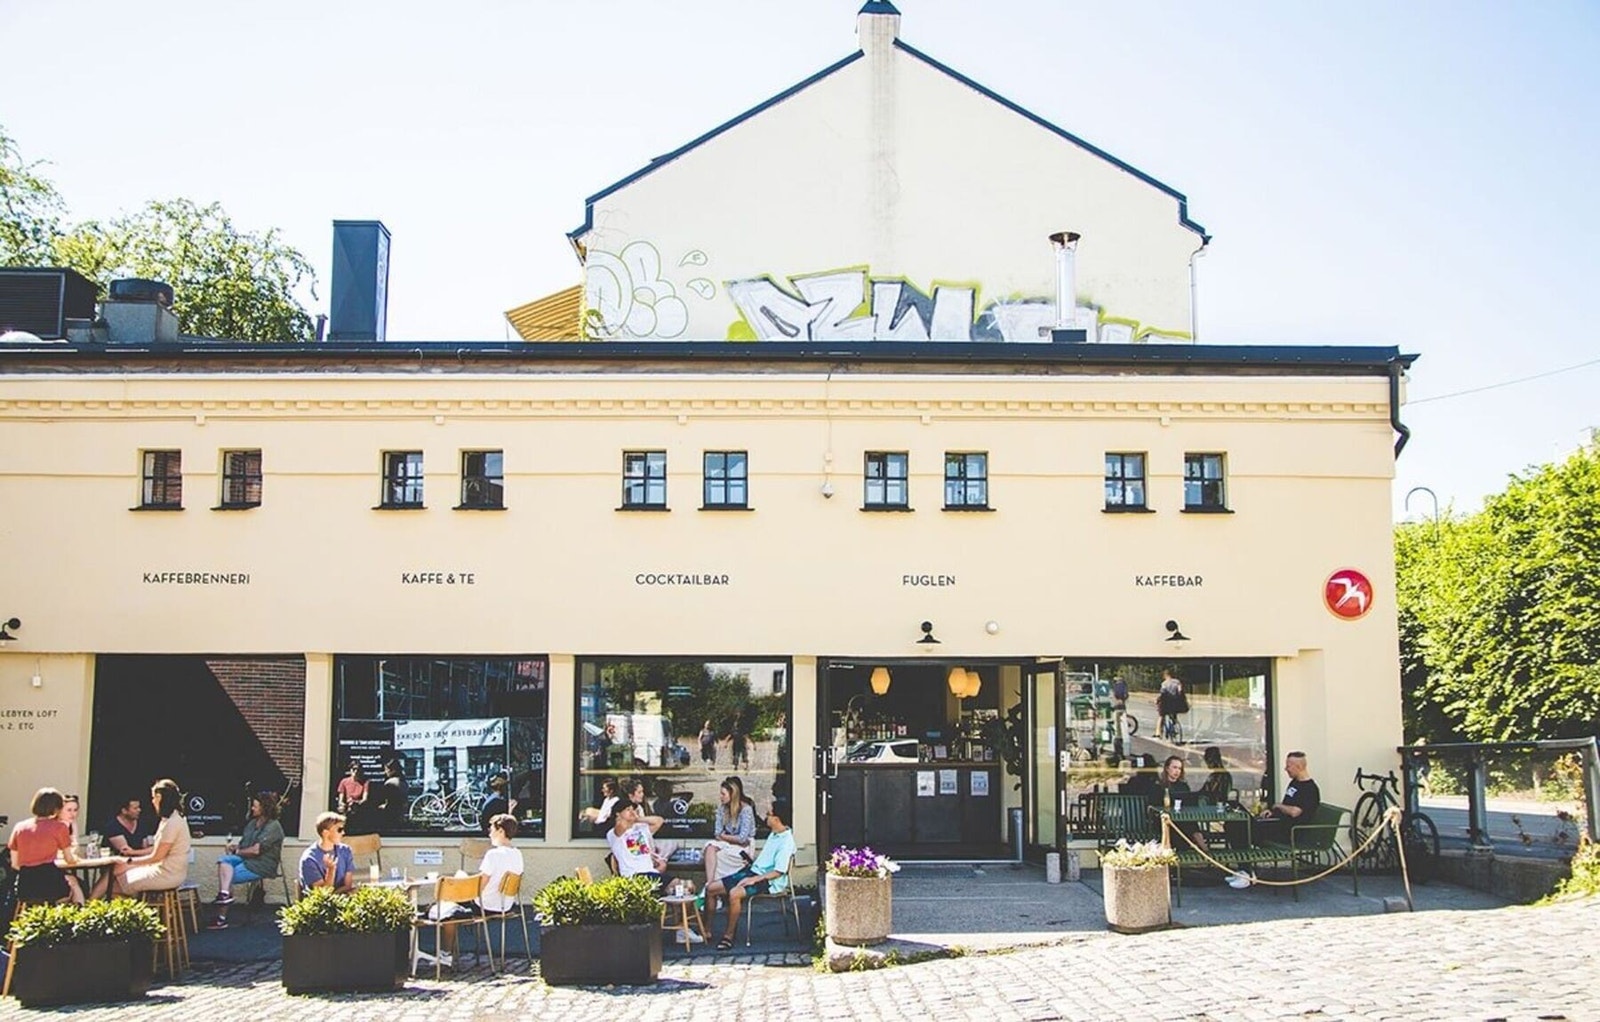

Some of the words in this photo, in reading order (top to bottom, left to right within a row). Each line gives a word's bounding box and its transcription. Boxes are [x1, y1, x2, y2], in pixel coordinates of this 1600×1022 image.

[142, 572, 251, 585] KAFFEBRENNERI
[401, 572, 446, 585] KAFFE
[447, 572, 456, 585] &
[459, 572, 475, 585] TE
[635, 573, 730, 586] COCKTAILBAR
[902, 574, 956, 587] FUGLEN
[1135, 574, 1204, 587] KAFFEBAR
[36, 709, 58, 718] LOFT
